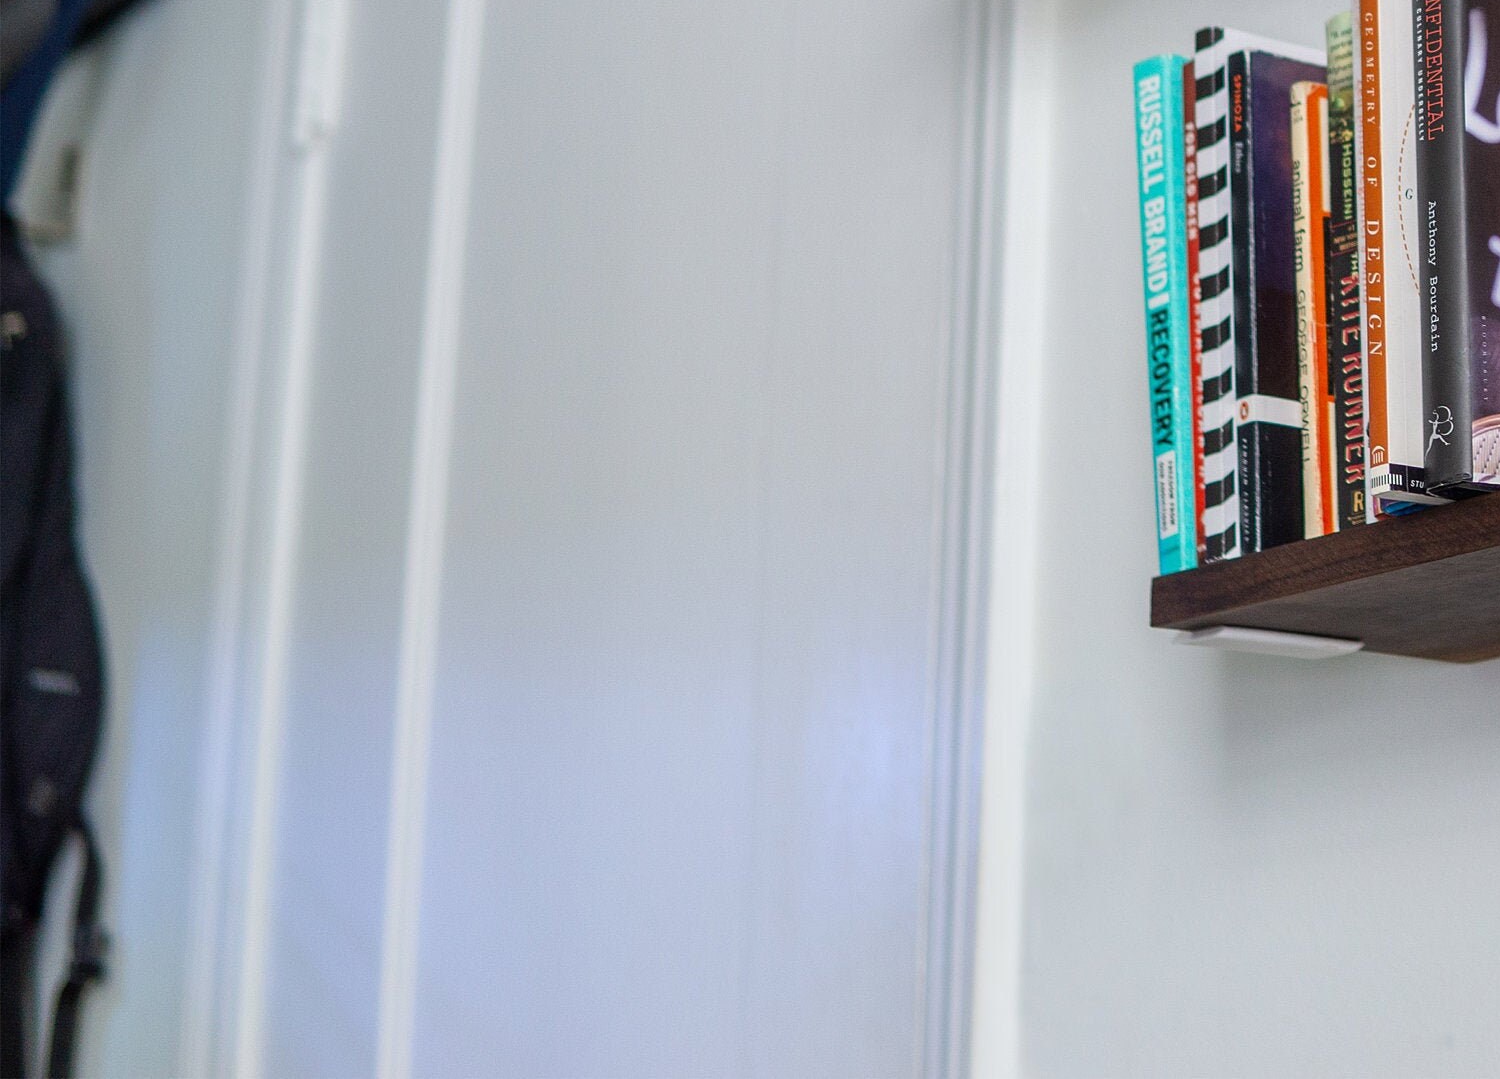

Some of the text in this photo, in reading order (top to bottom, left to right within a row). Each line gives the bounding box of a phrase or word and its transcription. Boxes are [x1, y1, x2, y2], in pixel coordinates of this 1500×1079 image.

[1233, 73, 1242, 133] SPINOZA
[1418, 68, 1426, 142] UNDERBELLY
[1292, 159, 1306, 221] animal
[1341, 142, 1353, 221] HOSSEINI
[1365, 12, 1383, 357] GEOMETRY OF DESIGN
[1138, 73, 1174, 447] RUSSELL BRAND RECOVERY
[1294, 228, 1306, 274] farm
[1427, 200, 1438, 353] Anthony Bourdain
[1298, 289, 1309, 377] GEORGE
[1342, 351, 1364, 485] RUNNER
